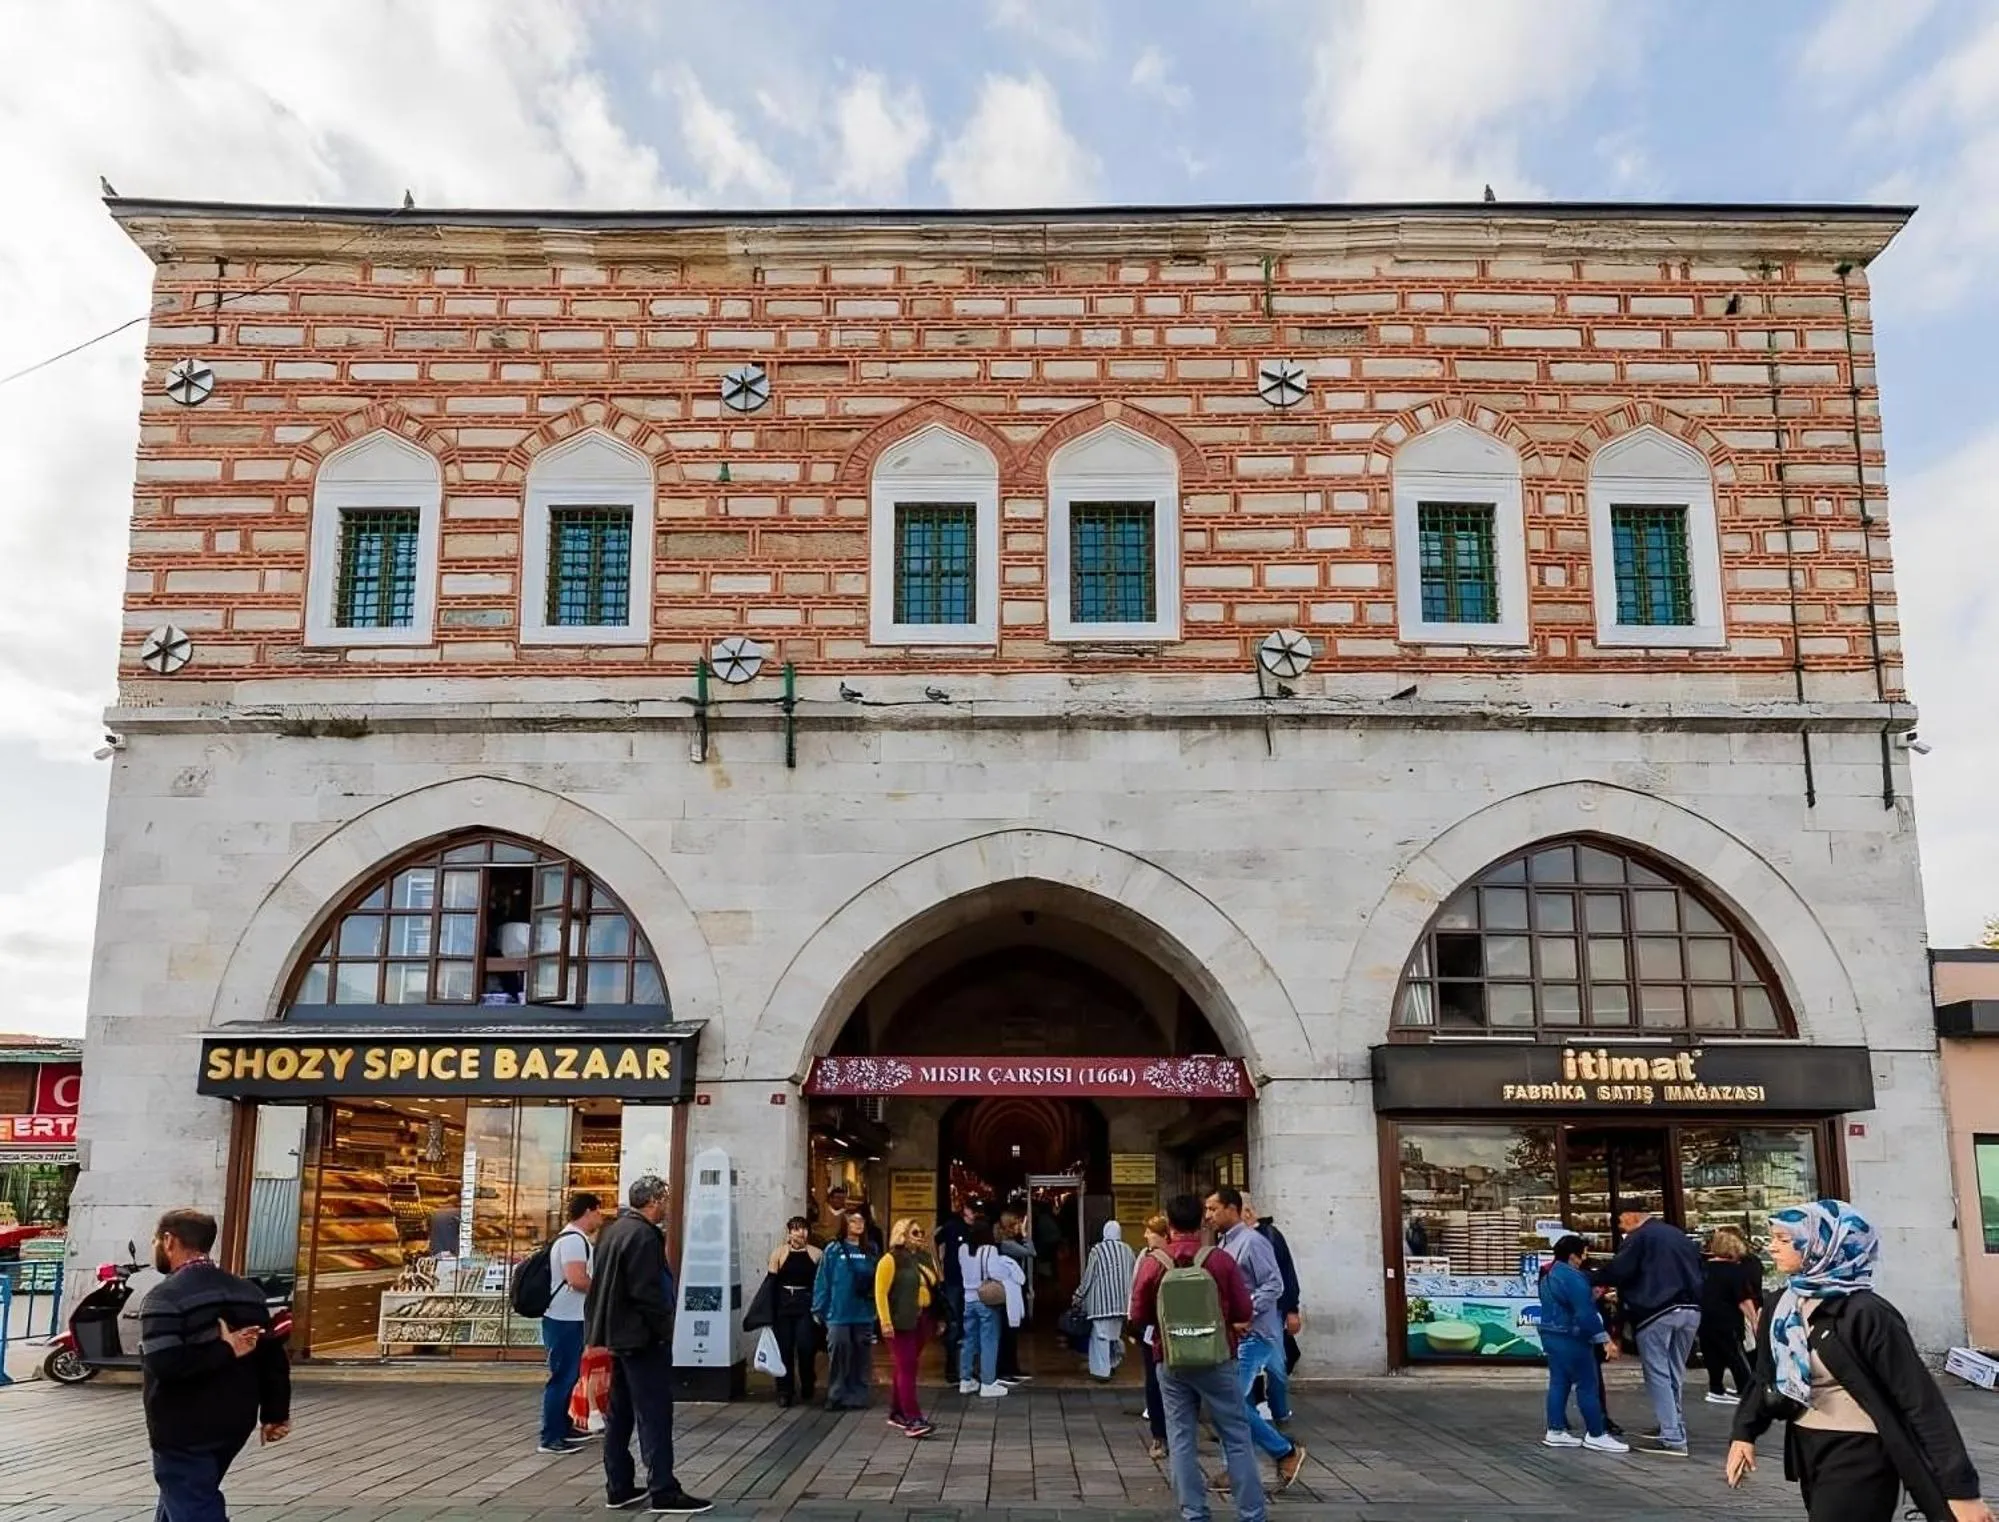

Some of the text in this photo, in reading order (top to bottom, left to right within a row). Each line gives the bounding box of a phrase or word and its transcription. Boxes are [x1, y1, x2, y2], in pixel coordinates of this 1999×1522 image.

[207, 1047, 672, 1080] SHOZY SPICE BAZAAR
[1563, 1048, 1697, 1081] itimat
[920, 1066, 1136, 1086] MISIR ÇARŞISI (1664)
[1503, 1082, 1766, 1104] FABRİKA SATIŞ MAĞAZASI
[14, 1117, 77, 1137] ERT
